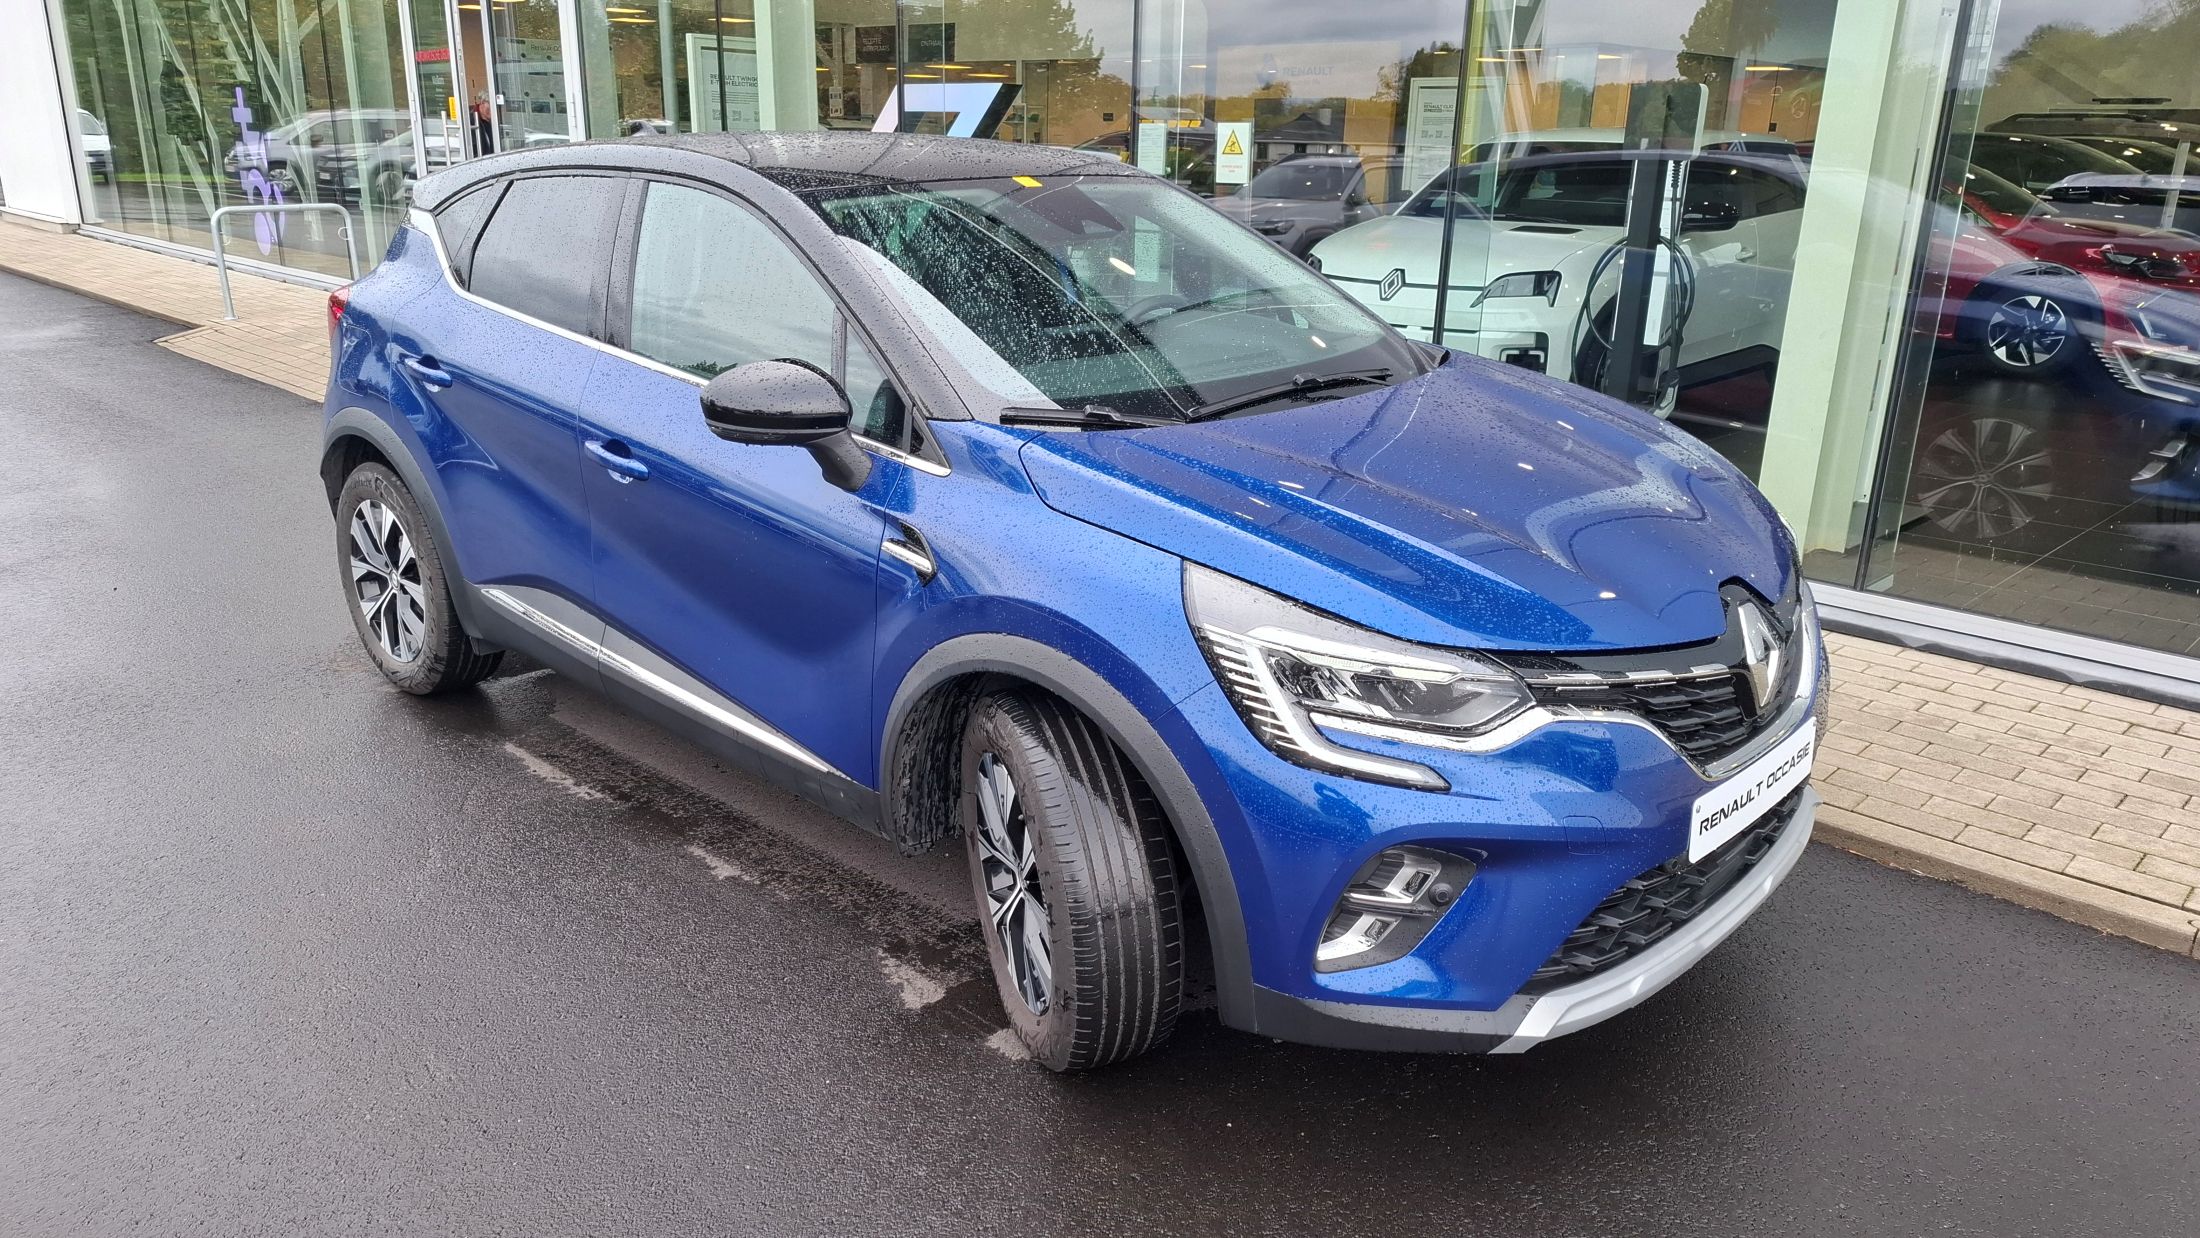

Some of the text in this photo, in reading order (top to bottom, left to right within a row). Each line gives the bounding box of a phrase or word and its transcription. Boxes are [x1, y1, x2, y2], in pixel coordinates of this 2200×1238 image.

[709, 73, 736, 81] REULT
[1282, 65, 1335, 77] RENAULT
[1699, 741, 1811, 836] RENAULT OCCASIE
